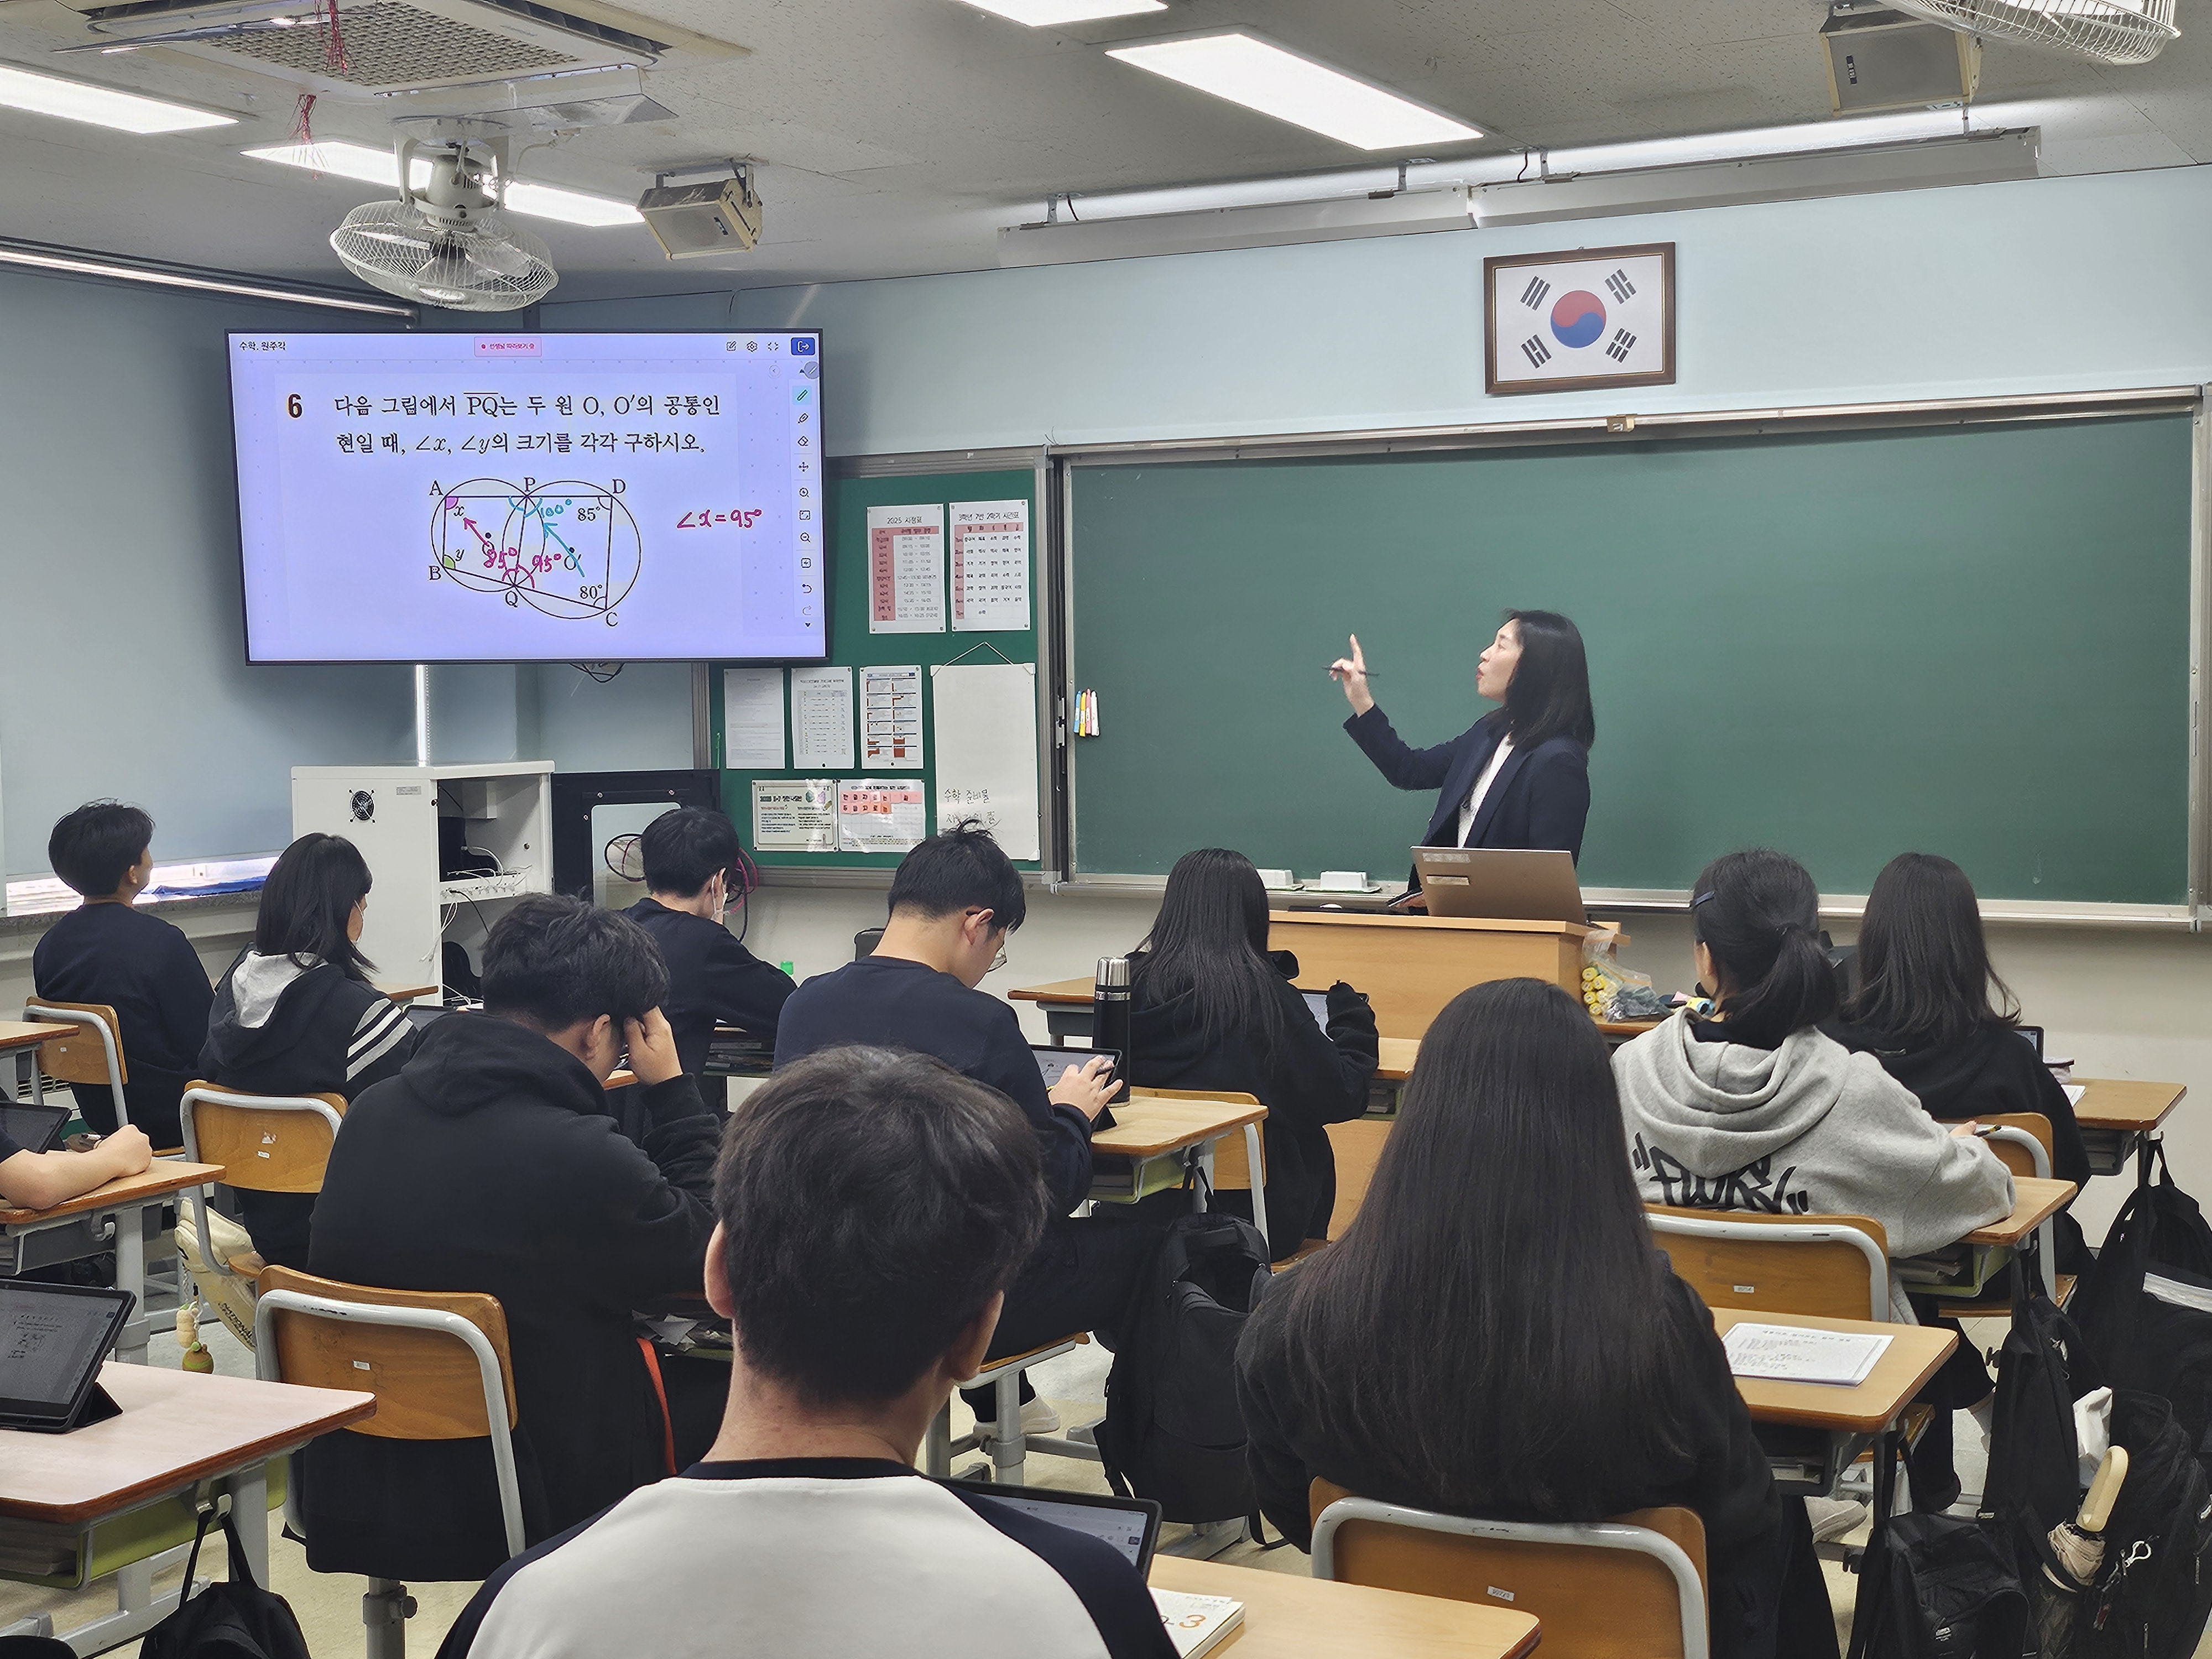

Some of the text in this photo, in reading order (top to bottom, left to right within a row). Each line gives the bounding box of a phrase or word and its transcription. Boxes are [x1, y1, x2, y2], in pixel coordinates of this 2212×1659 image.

[261, 341, 286, 351] 원주각
[288, 393, 302, 418] 6
[334, 395, 373, 416] 다음
[382, 395, 456, 416] 그림에서
[527, 396, 546, 416] 두
[555, 395, 573, 416] 원
[664, 395, 719, 416] 공통인
[337, 432, 374, 453] 현일
[381, 432, 405, 455] 때,
[516, 432, 573, 453] 크기를
[580, 432, 618, 453] 각각
[624, 432, 705, 453] 구하시오.
[429, 480, 444, 496] A
[523, 477, 536, 492] P
[612, 479, 626, 494] D
[453, 505, 465, 517] x
[455, 549, 465, 562] y
[429, 566, 441, 581] B
[505, 590, 518, 608] Q
[606, 612, 618, 627] C
[945, 789, 961, 804] 수학
[1179, 1614, 1206, 1628] 3
